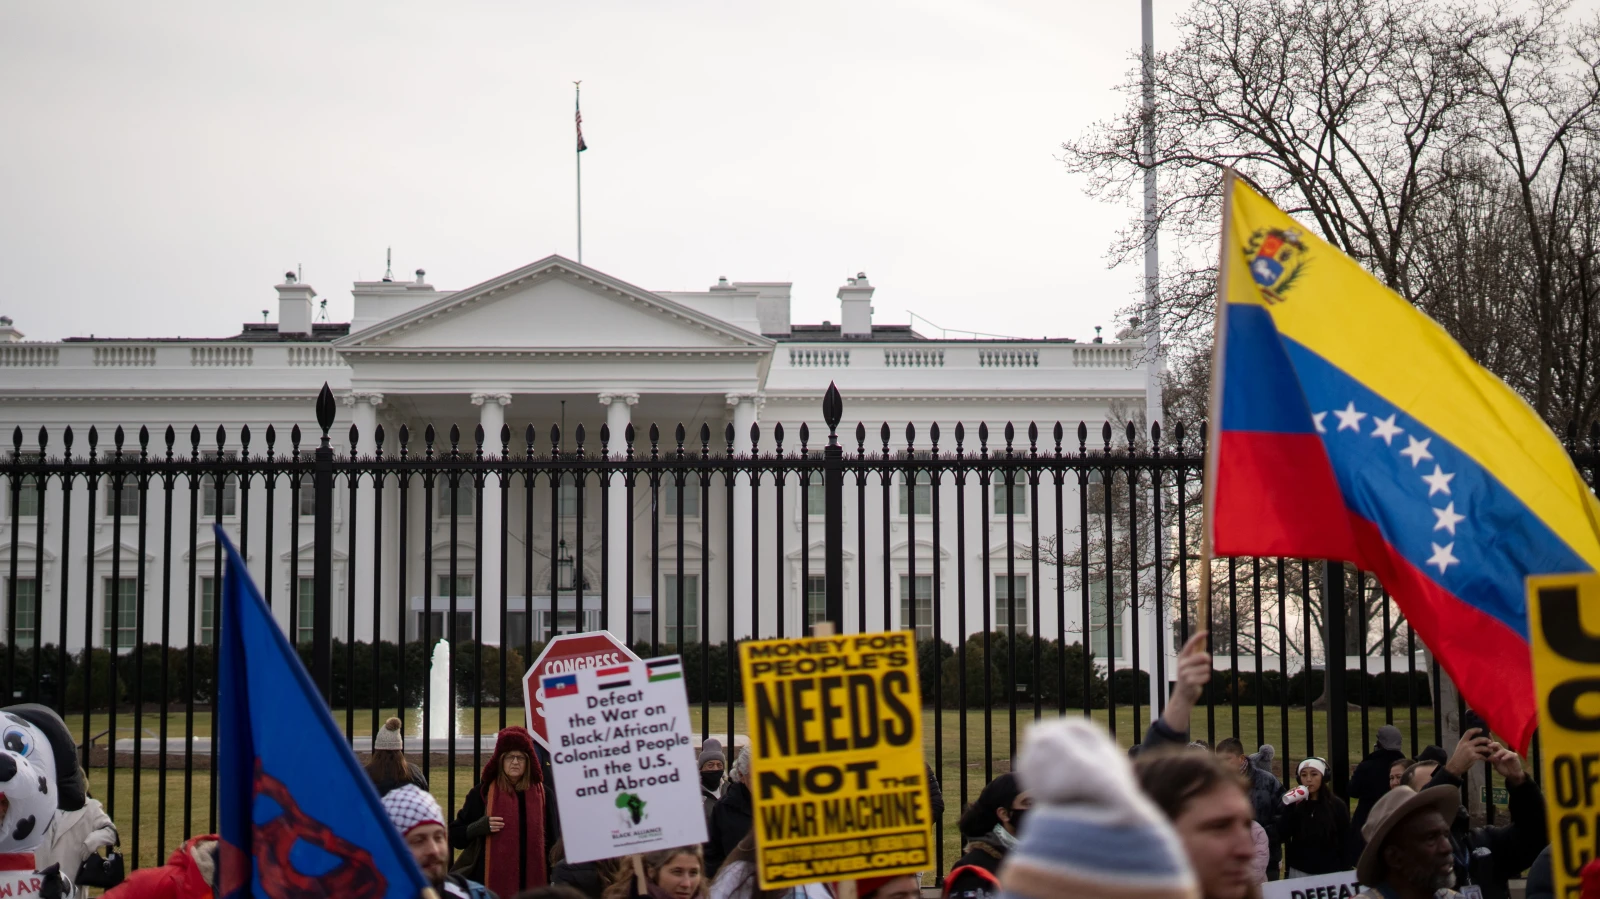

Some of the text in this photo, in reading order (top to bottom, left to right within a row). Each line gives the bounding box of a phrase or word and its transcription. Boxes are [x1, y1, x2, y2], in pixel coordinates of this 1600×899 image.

[750, 634, 908, 659] MONEY FOR
[545, 653, 619, 675] CONGRESS
[752, 651, 908, 678] PEOPLE'S
[586, 689, 644, 709] Defeat
[568, 704, 666, 728] the War on
[754, 670, 915, 759] NEEDS
[560, 716, 677, 747] Black/African/
[554, 734, 689, 765] Colonized People
[583, 753, 672, 779] in the U.S.
[575, 768, 680, 798] and Abroad
[758, 760, 921, 800] NOT THE
[761, 790, 925, 841] WAR MACHINE
[612, 827, 662, 839] BLACK ALLIANCE
[767, 850, 925, 881] PSLWEB.ORG
[0, 878, 42, 898] WAR
[1291, 881, 1361, 899] DEFEAT
